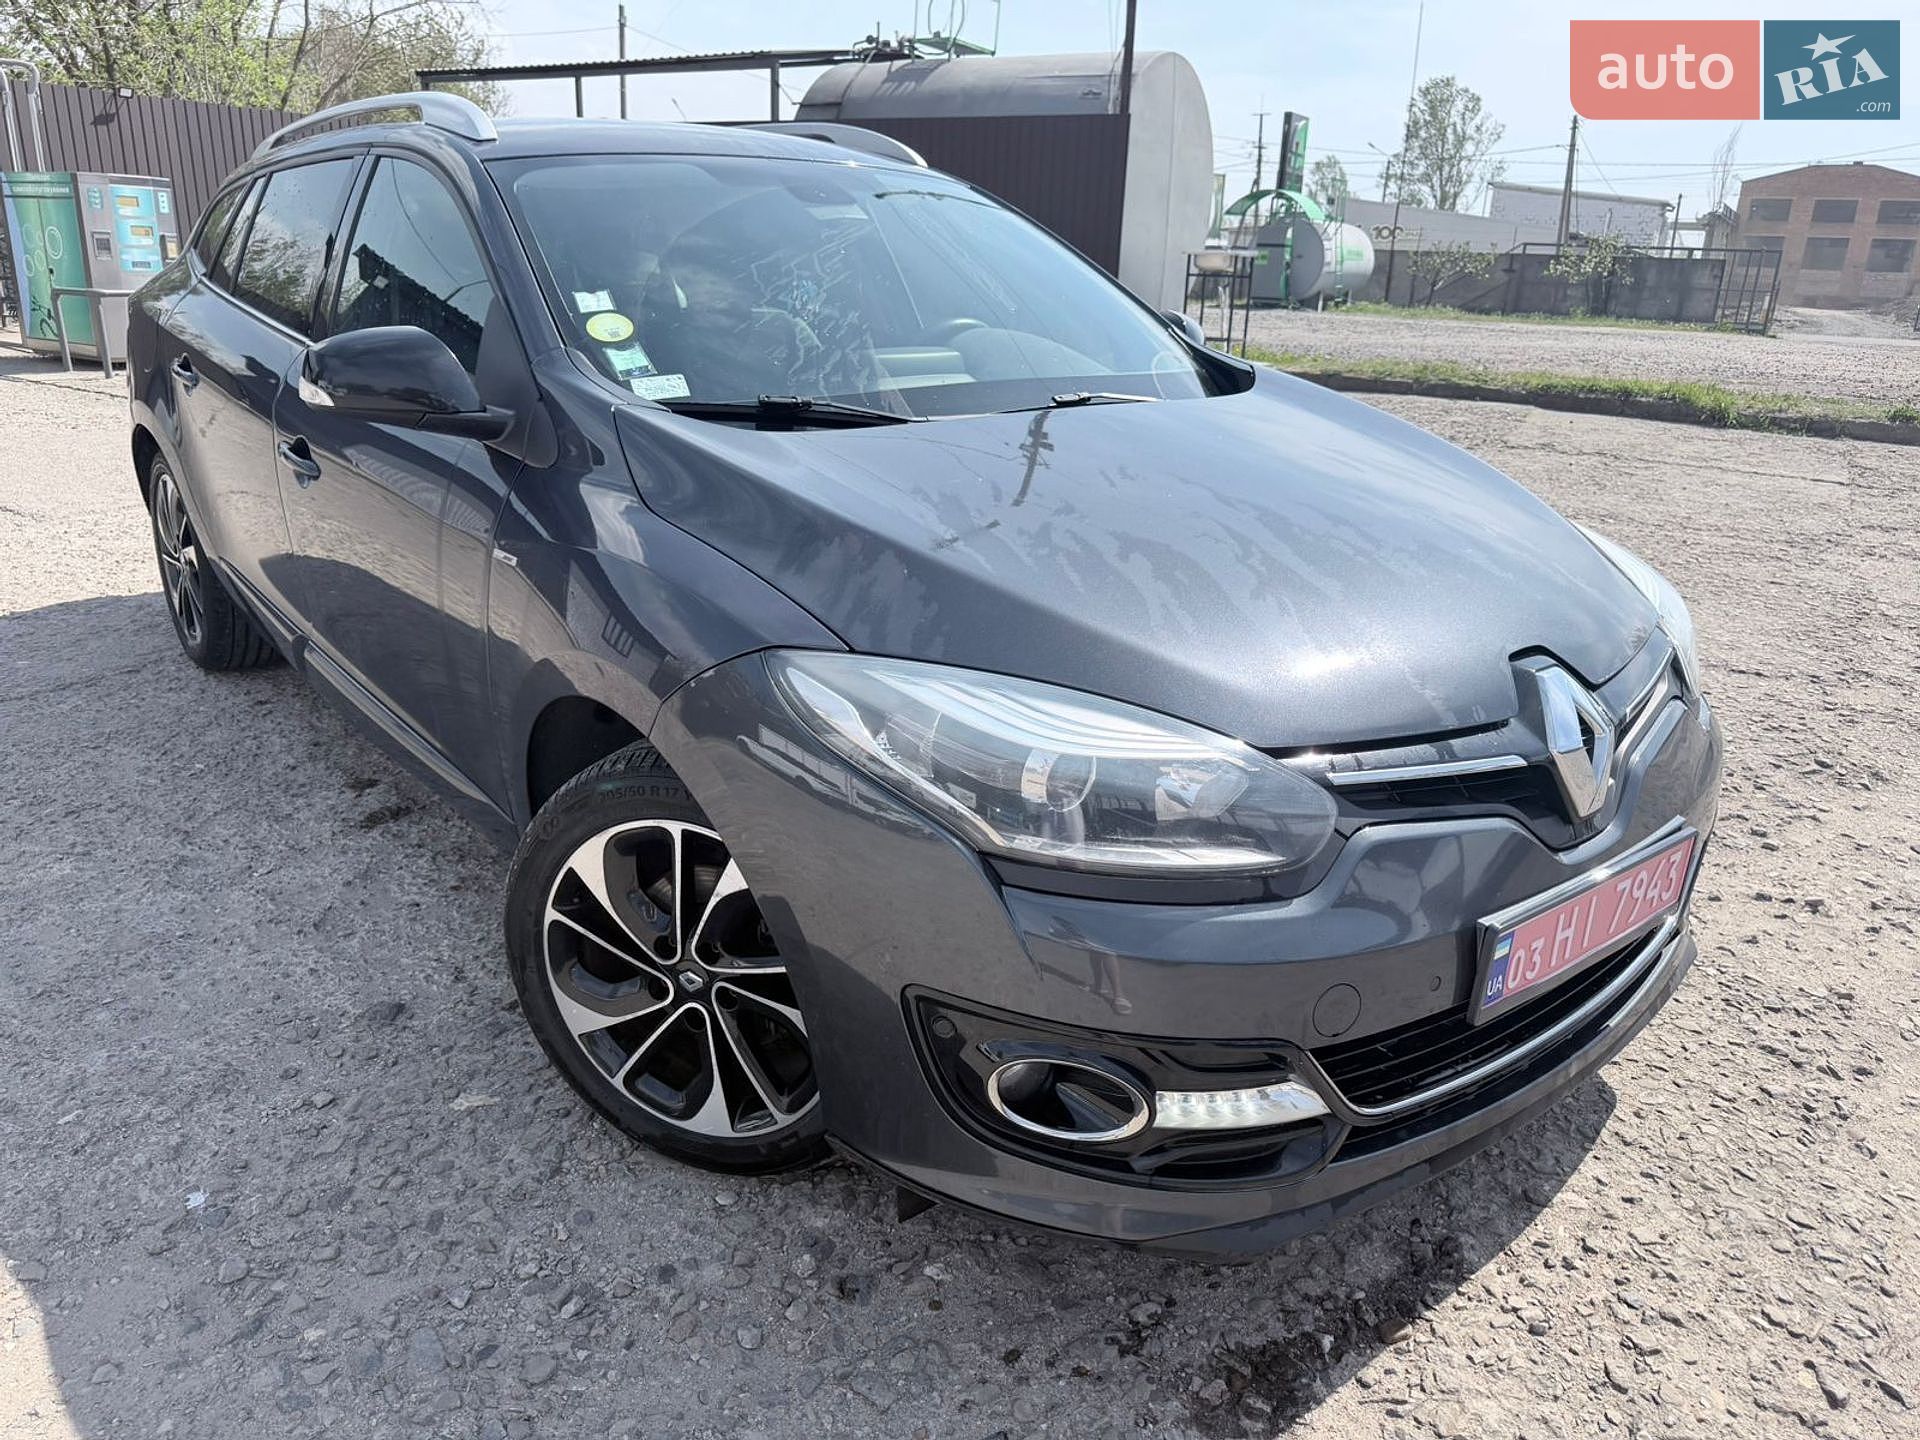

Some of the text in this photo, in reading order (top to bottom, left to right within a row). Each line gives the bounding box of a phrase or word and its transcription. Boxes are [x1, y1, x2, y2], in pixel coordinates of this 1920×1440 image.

[1507, 852, 1683, 989] 03 HI 7943
[1486, 977, 1503, 996] UA
